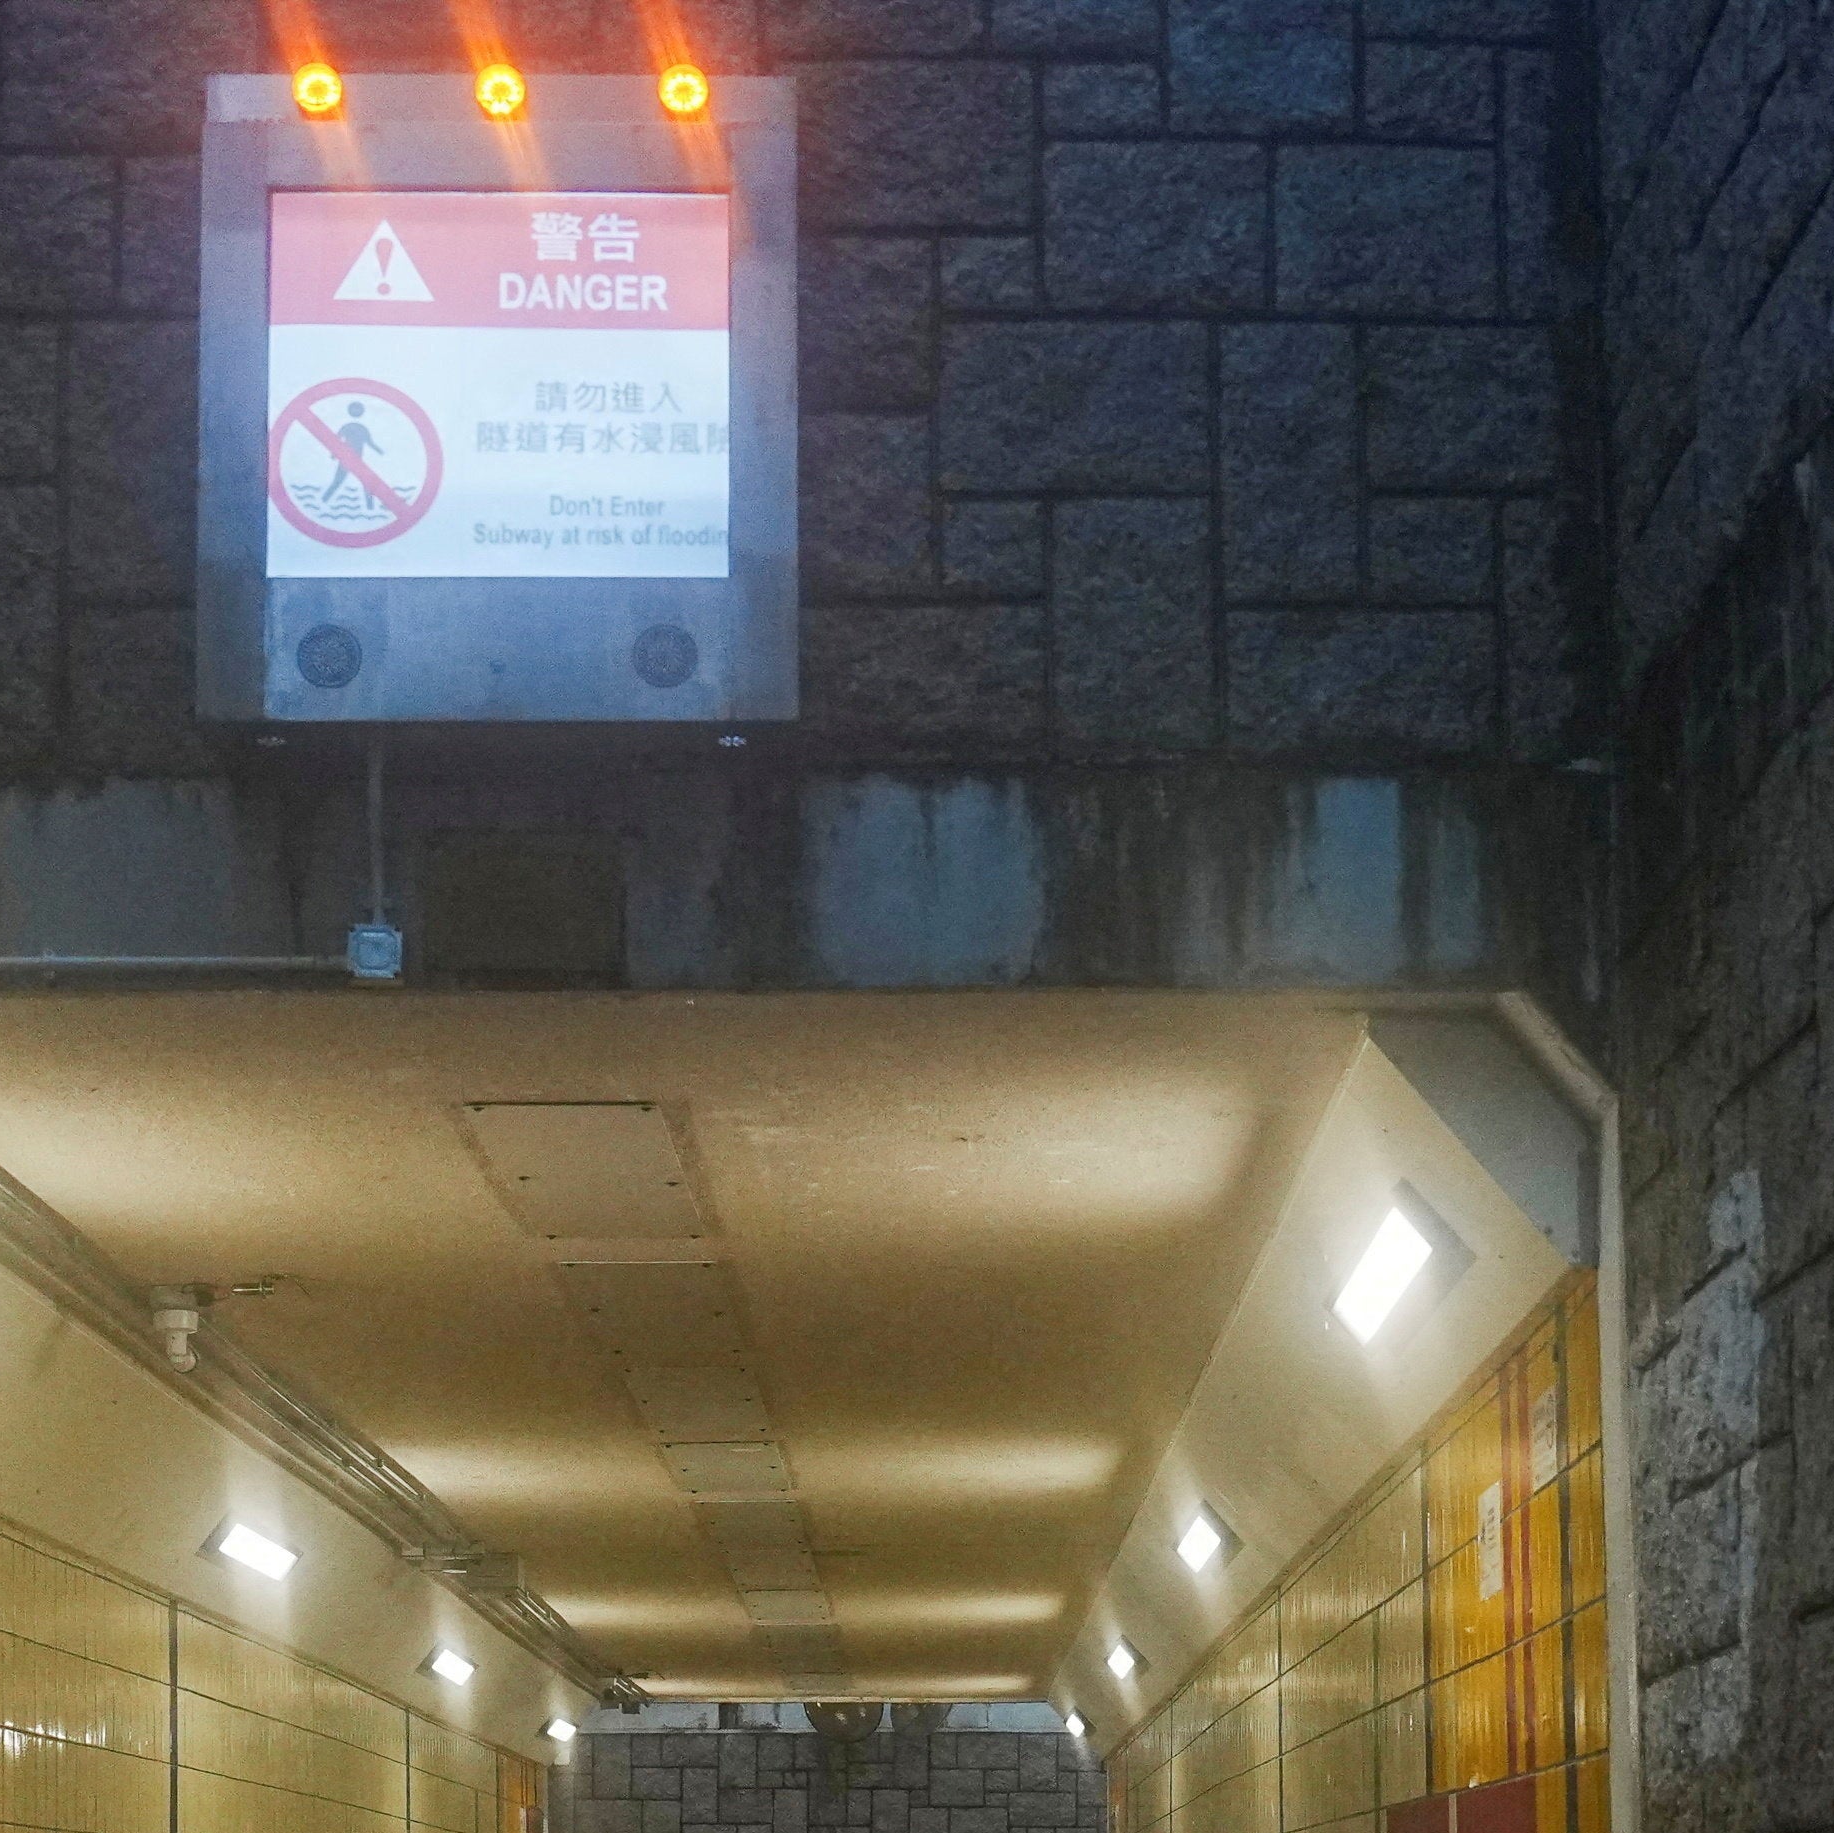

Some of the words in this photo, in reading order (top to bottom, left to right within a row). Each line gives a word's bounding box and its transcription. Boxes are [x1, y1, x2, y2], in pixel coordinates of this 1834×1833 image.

[531, 211, 640, 262] 警告
[499, 272, 668, 311] DANGER
[535, 381, 682, 413] 請勿進入
[550, 495, 604, 517] Don't
[611, 495, 665, 517] Enter
[473, 523, 554, 549] Subway
[562, 525, 579, 546] at
[586, 524, 625, 547] risk
[631, 524, 652, 546] of
